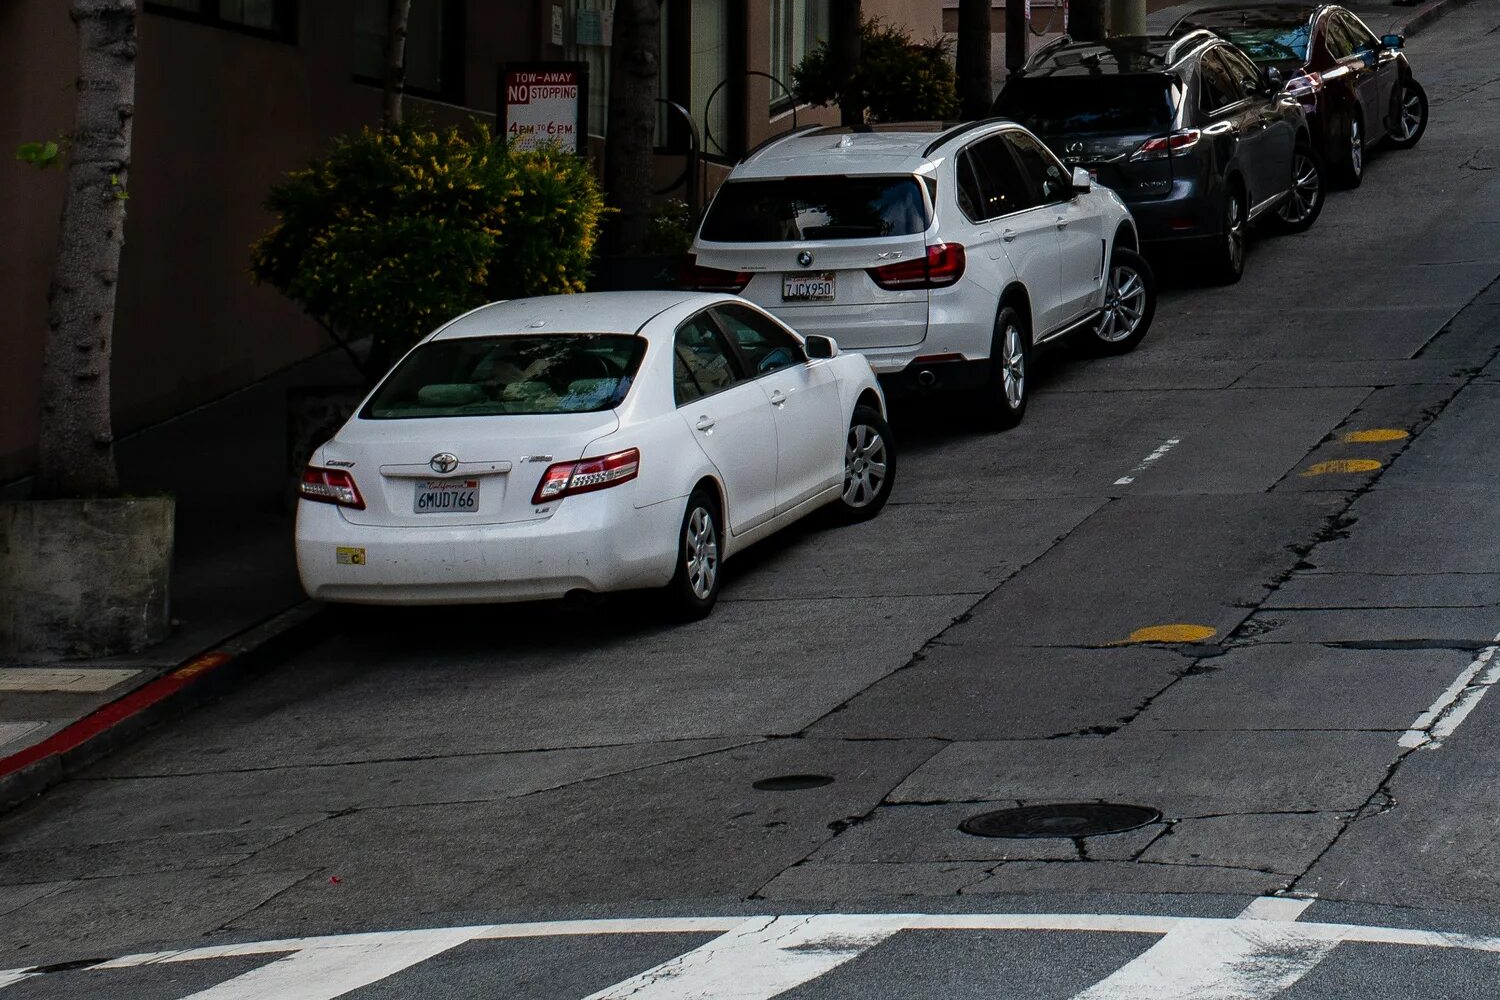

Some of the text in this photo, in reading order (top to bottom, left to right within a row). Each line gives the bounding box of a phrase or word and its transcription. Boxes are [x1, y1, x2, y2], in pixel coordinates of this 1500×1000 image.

[515, 72, 572, 84] TOW-AWAY
[508, 85, 577, 102] NO STOPPING
[786, 282, 831, 297] 7JCX950
[417, 491, 475, 509] 6MUD766
